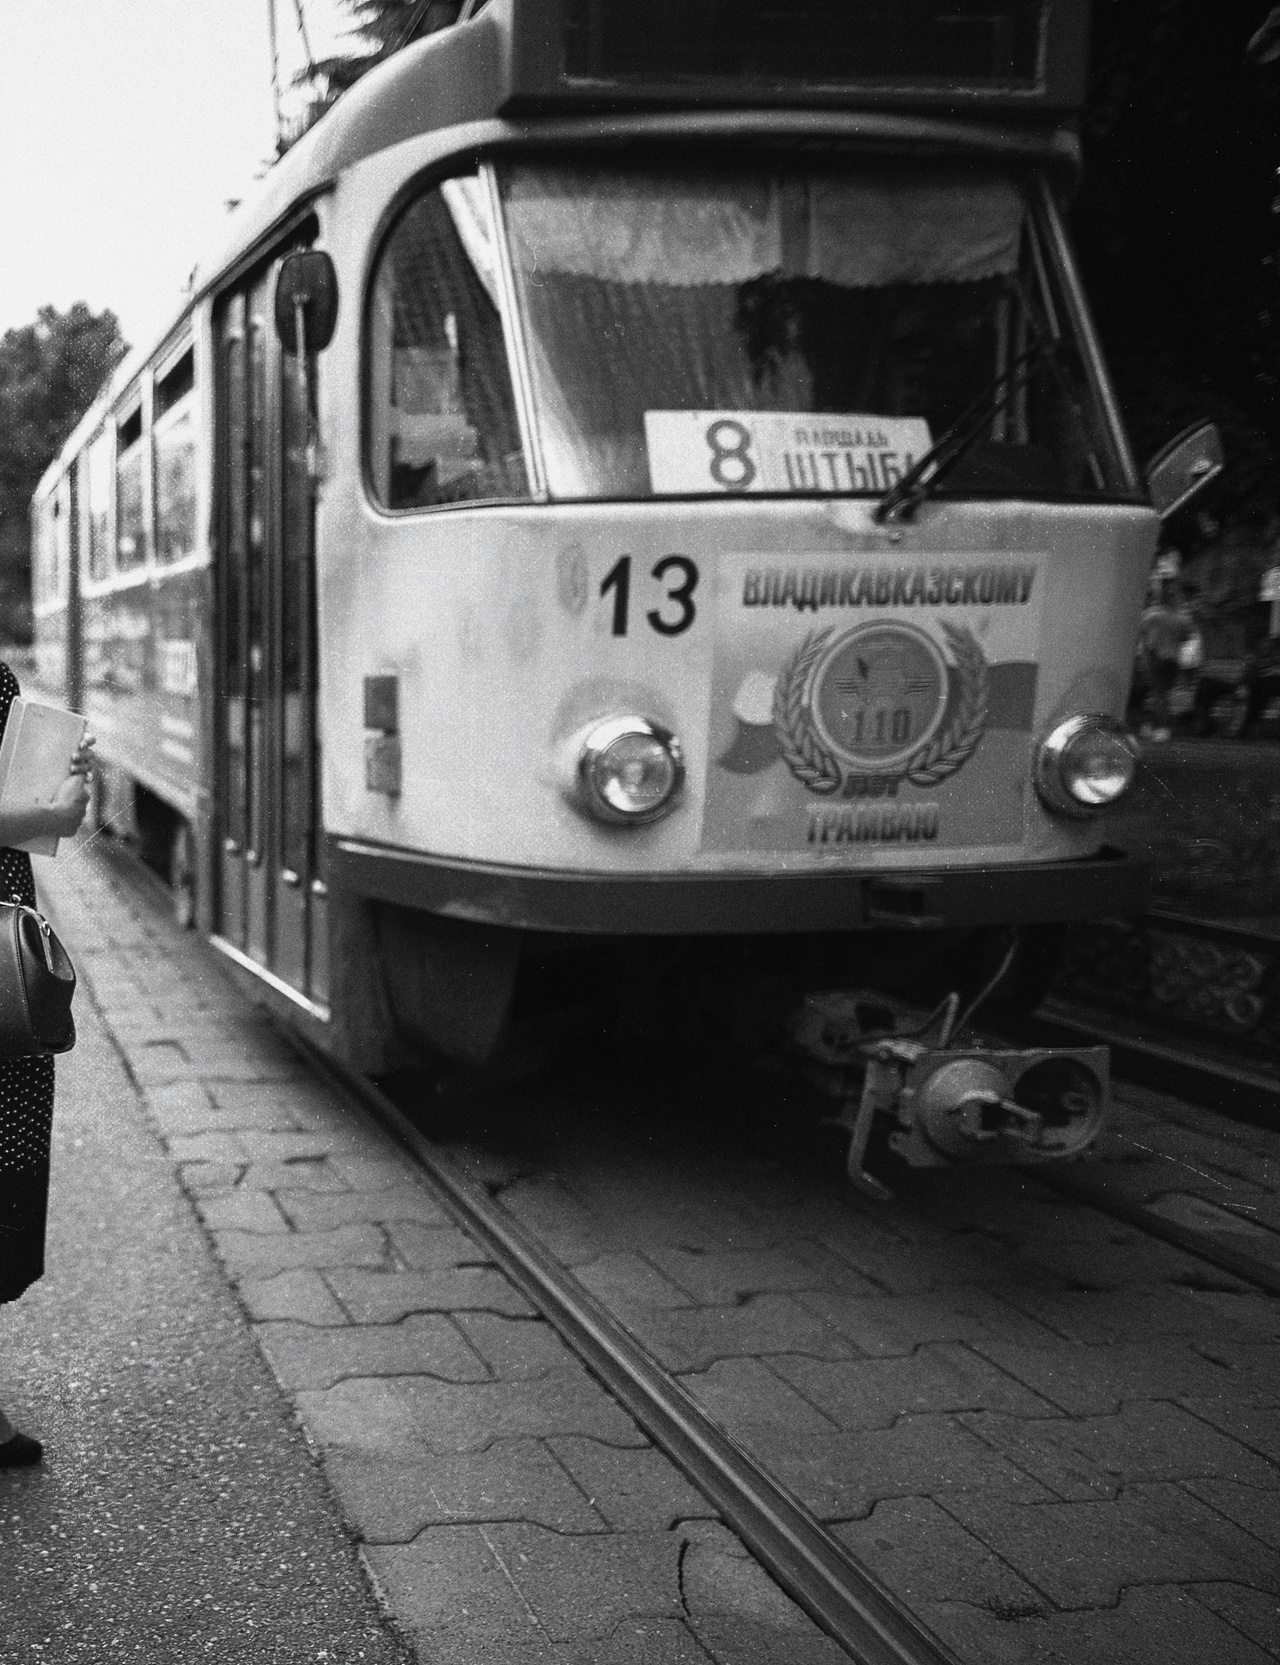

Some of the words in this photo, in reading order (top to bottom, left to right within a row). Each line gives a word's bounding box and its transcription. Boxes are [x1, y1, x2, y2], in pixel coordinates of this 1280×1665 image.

[706, 420, 756, 491] 8
[599, 553, 700, 638] 13
[742, 565, 1038, 612] ВЛАДИКАВКАЗСКОМУ
[853, 708, 912, 743] 110
